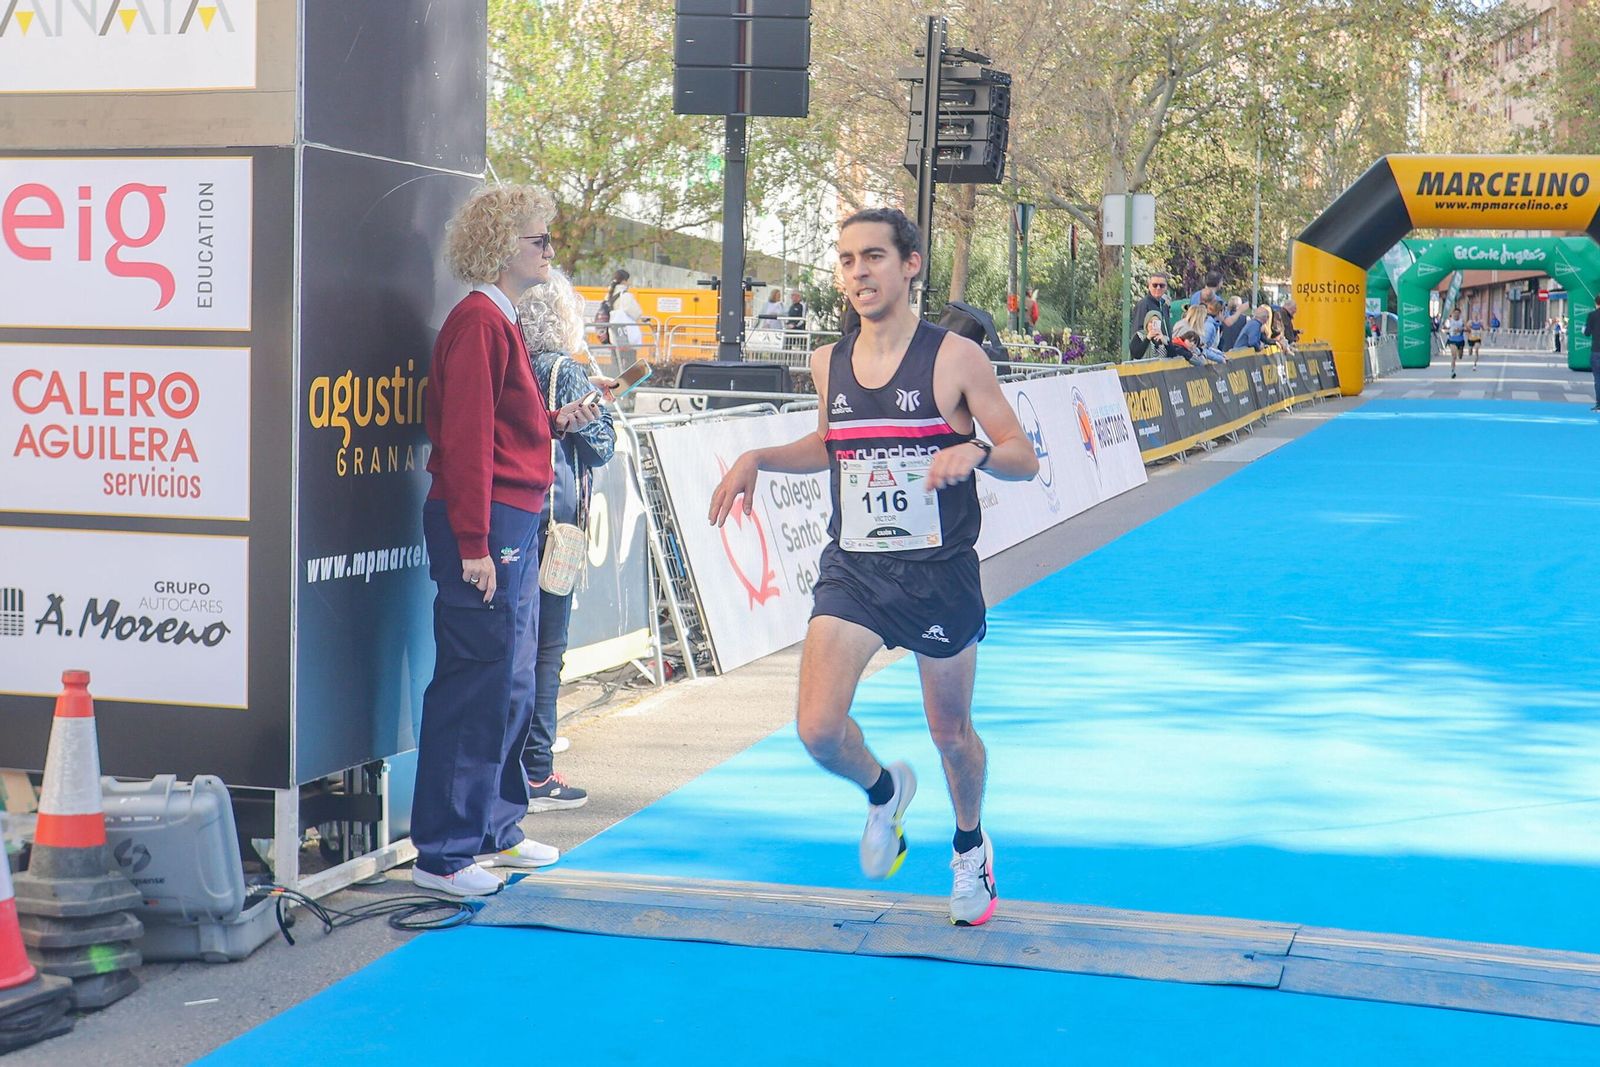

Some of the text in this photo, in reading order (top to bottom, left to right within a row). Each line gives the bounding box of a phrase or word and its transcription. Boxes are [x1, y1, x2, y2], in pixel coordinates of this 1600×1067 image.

[1416, 171, 1590, 197] MARCELINO
[1434, 199, 1569, 212] www.mpmarcelino.es
[1, 182, 176, 311] eig
[197, 181, 214, 309] EDUCATION
[1453, 245, 1467, 260] El
[1468, 245, 1500, 260] Corte
[1296, 280, 1360, 298] agustinos
[12, 368, 200, 419] CALERO
[13, 423, 199, 463] AGUILERA
[103, 466, 201, 499] servicios
[770, 476, 821, 510] Colegio
[862, 490, 908, 513] 116
[781, 519, 822, 553] Santo
[154, 581, 210, 596] GRUPO
[139, 597, 223, 614] AUTOCARES
[79, 598, 231, 647] Moreno
